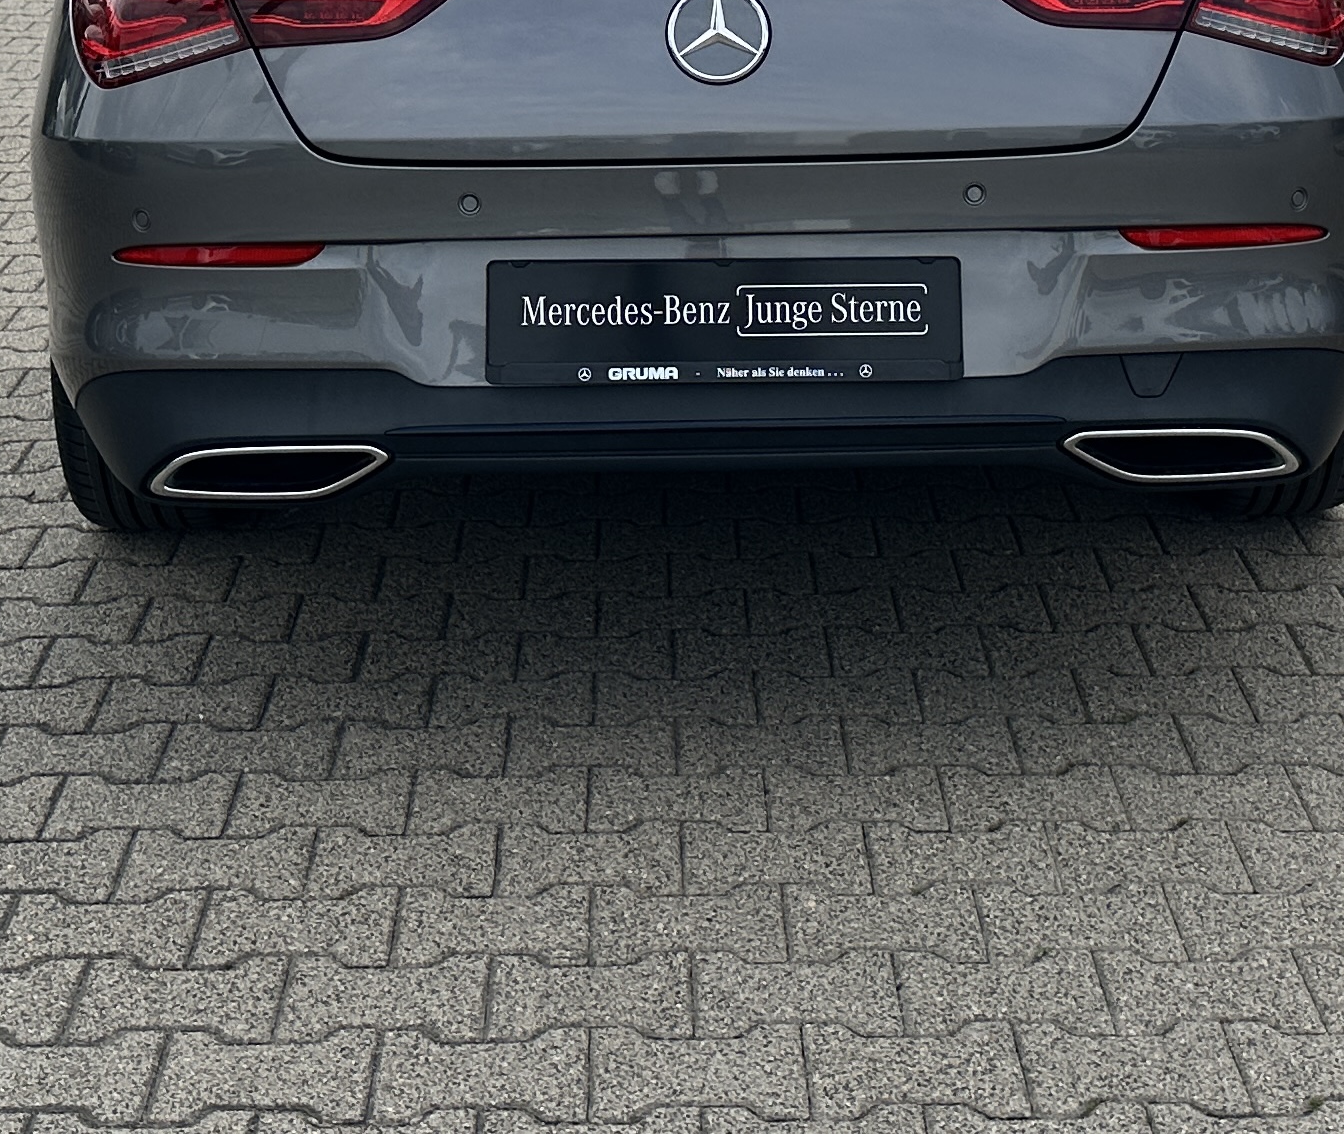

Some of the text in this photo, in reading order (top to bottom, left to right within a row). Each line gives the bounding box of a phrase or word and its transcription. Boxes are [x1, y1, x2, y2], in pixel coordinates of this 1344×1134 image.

[521, 292, 921, 330] Mercedes-Benz Junge Sterne
[607, 366, 679, 381] GRUMA
[716, 367, 749, 378] Näher
[751, 367, 767, 377] als
[768, 366, 785, 377] Sie
[786, 366, 825, 377] denken
